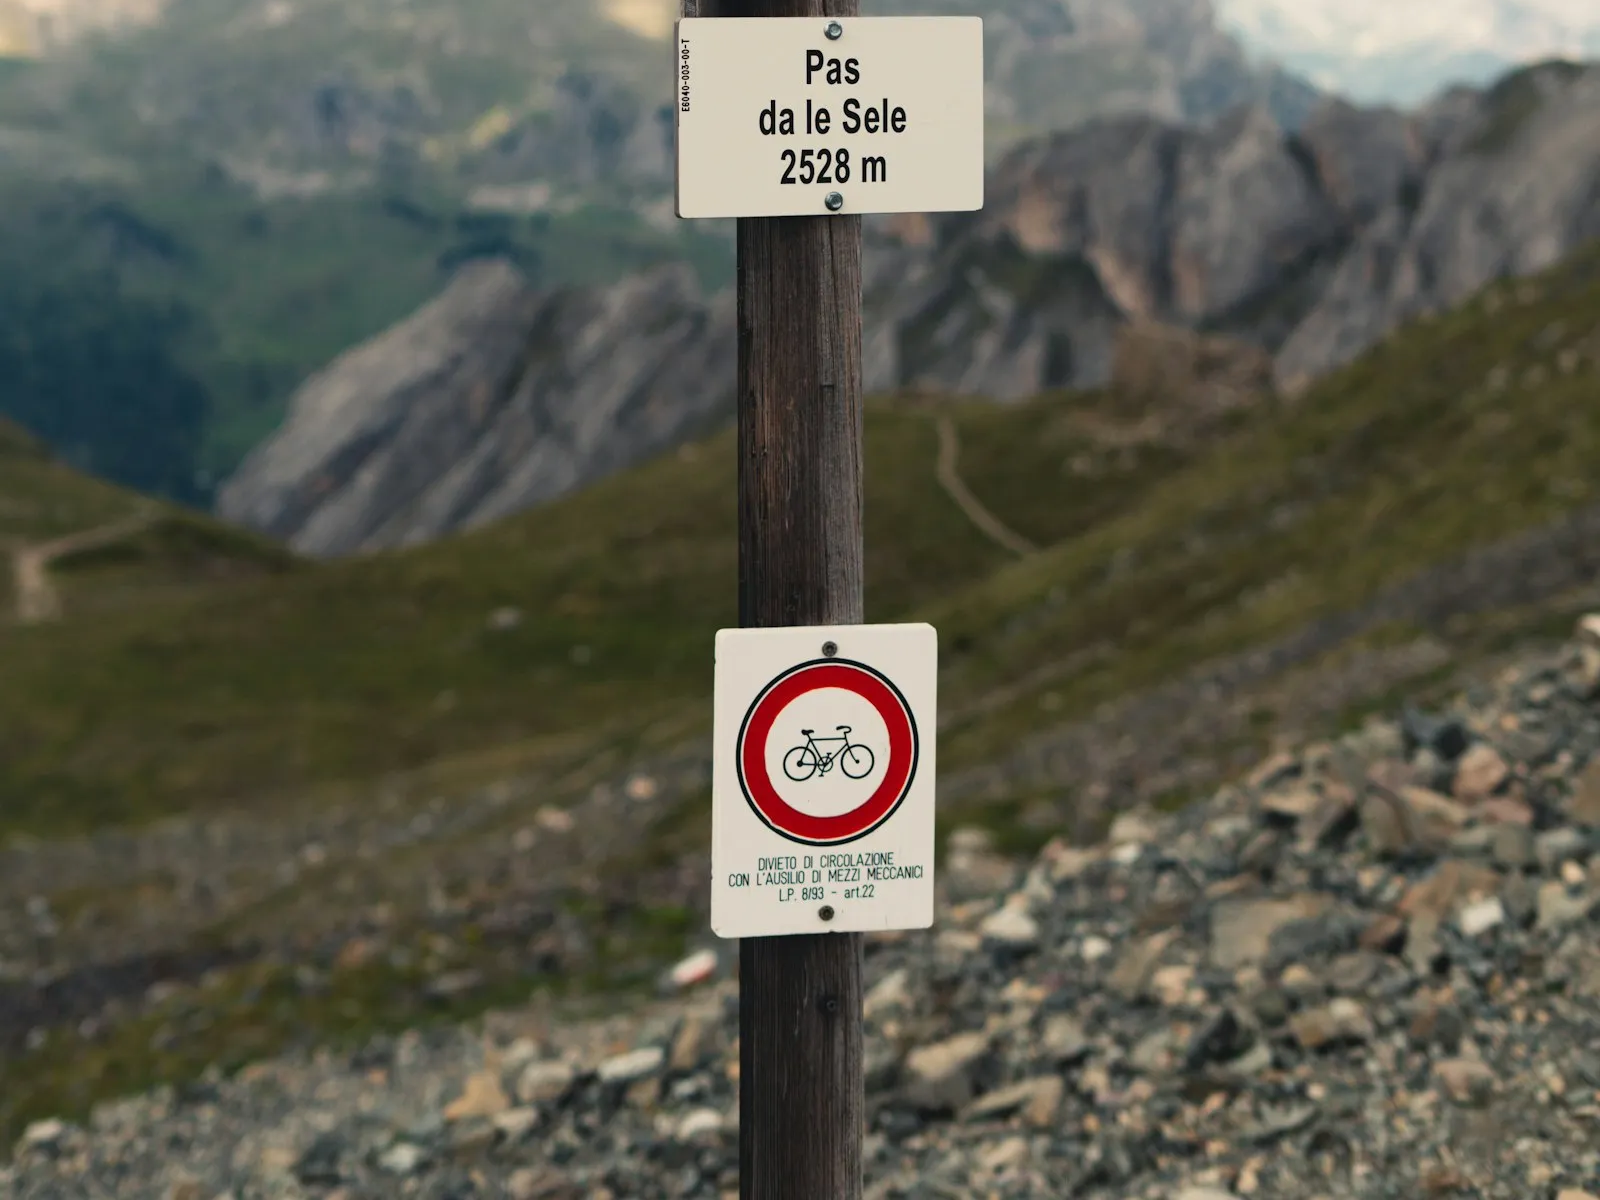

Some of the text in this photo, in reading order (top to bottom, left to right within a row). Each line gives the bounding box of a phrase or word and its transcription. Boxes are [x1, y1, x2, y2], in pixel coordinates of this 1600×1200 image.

[681, 38, 690, 112] E6040-003-00-T
[806, 49, 860, 85] Pas
[759, 97, 907, 136] da le Sele
[780, 147, 886, 185] 2528 m
[729, 866, 923, 887] CON L'AUSILIO DI MEZZI MECCANICI
[758, 852, 894, 871] DIVIETO DI CIRCOLAZIONE
[779, 889, 796, 901] L.P.
[801, 886, 824, 901] 8/93
[844, 884, 875, 899] art.22
